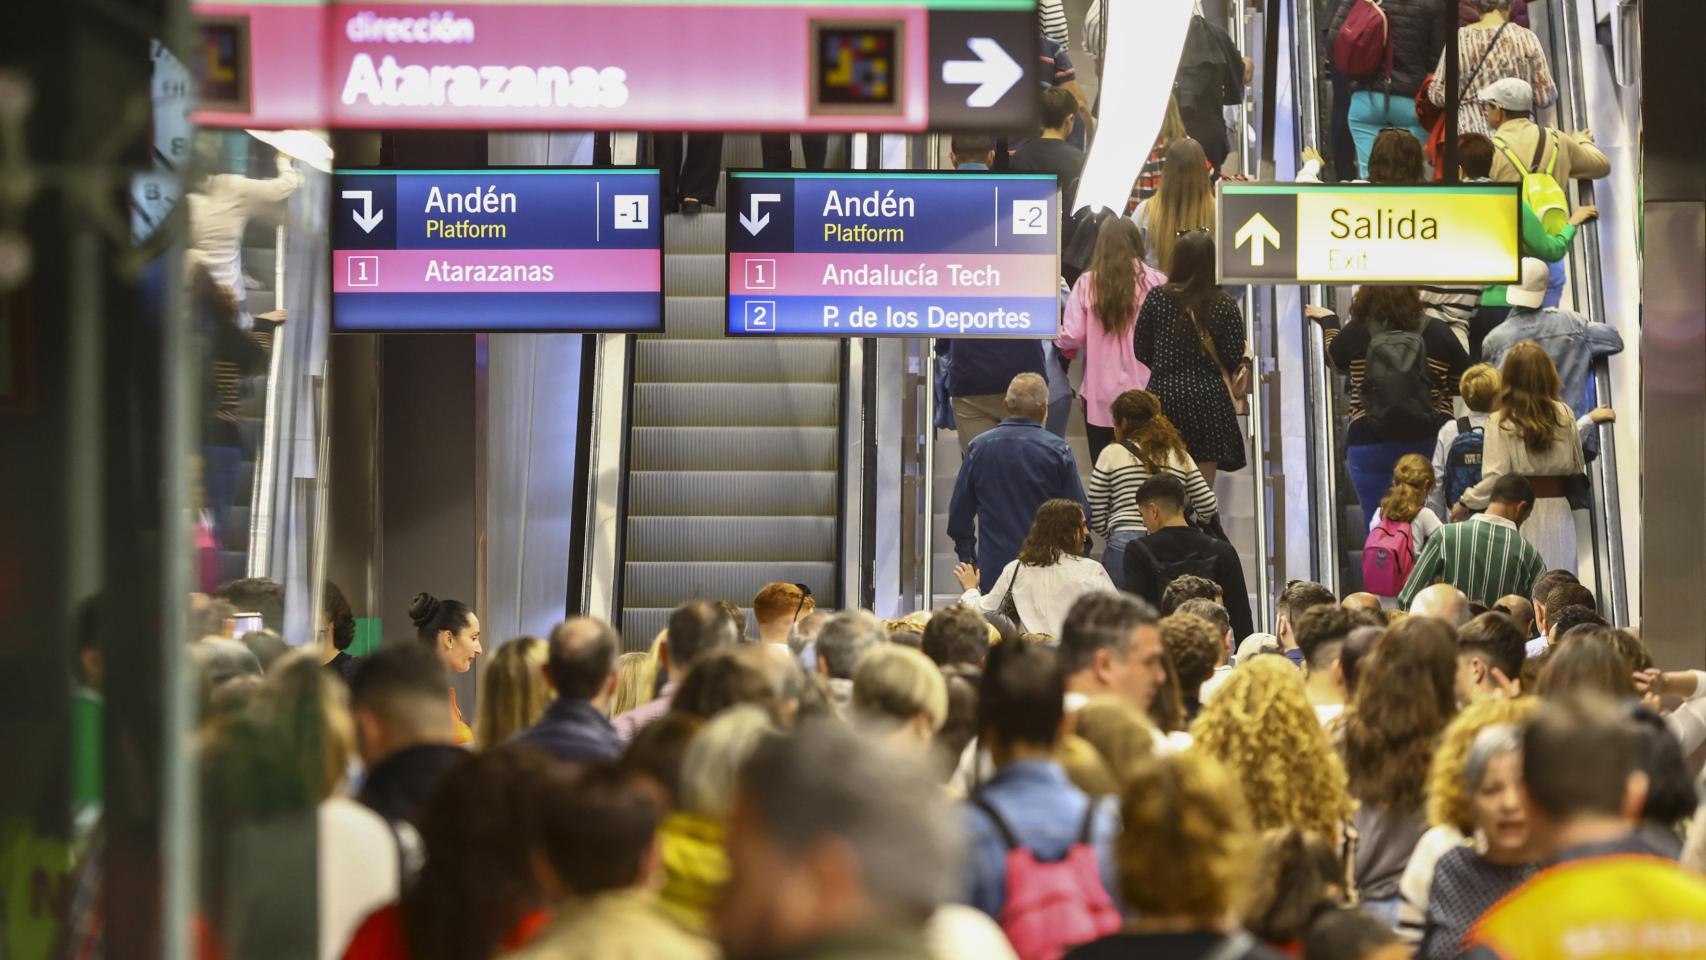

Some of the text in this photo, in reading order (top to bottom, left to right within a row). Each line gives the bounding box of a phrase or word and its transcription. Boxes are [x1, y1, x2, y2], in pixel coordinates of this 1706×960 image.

[346, 11, 475, 43] dirección
[341, 53, 629, 107] Atarazanas
[425, 185, 517, 213] Andén
[822, 190, 915, 217] Andén
[619, 201, 643, 223] -1
[1018, 206, 1043, 228] -2
[426, 220, 506, 238] Platform
[824, 224, 904, 242] Platform
[1330, 208, 1437, 240] Salida
[1329, 248, 1368, 270] Exit
[357, 262, 368, 281] 1
[425, 260, 554, 282] Atarazanas
[755, 265, 765, 284] 1
[822, 263, 1000, 286] Andalucía Tech
[753, 307, 767, 326] 2
[823, 306, 1031, 333] P. de los Deportes
